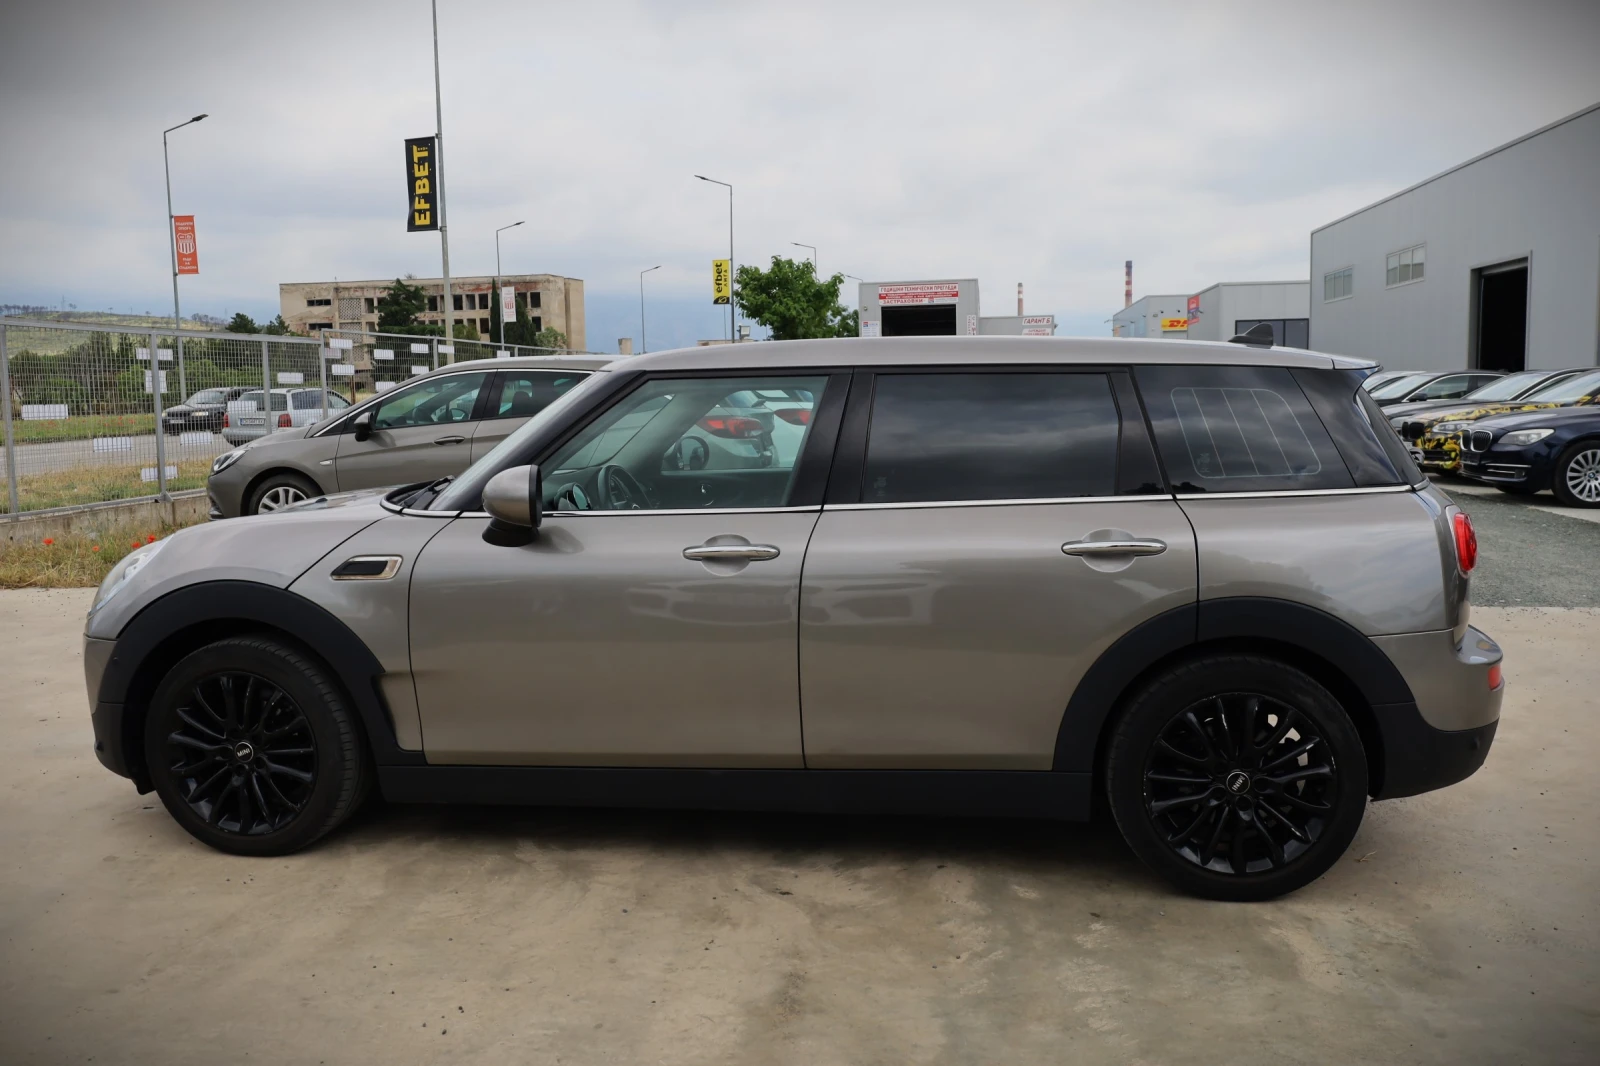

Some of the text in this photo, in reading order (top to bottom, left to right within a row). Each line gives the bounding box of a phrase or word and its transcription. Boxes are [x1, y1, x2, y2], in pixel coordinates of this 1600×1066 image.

[413, 145, 431, 226] EFBET
[714, 262, 723, 294] efbet
[1023, 317, 1046, 325] ГАРАНТ
